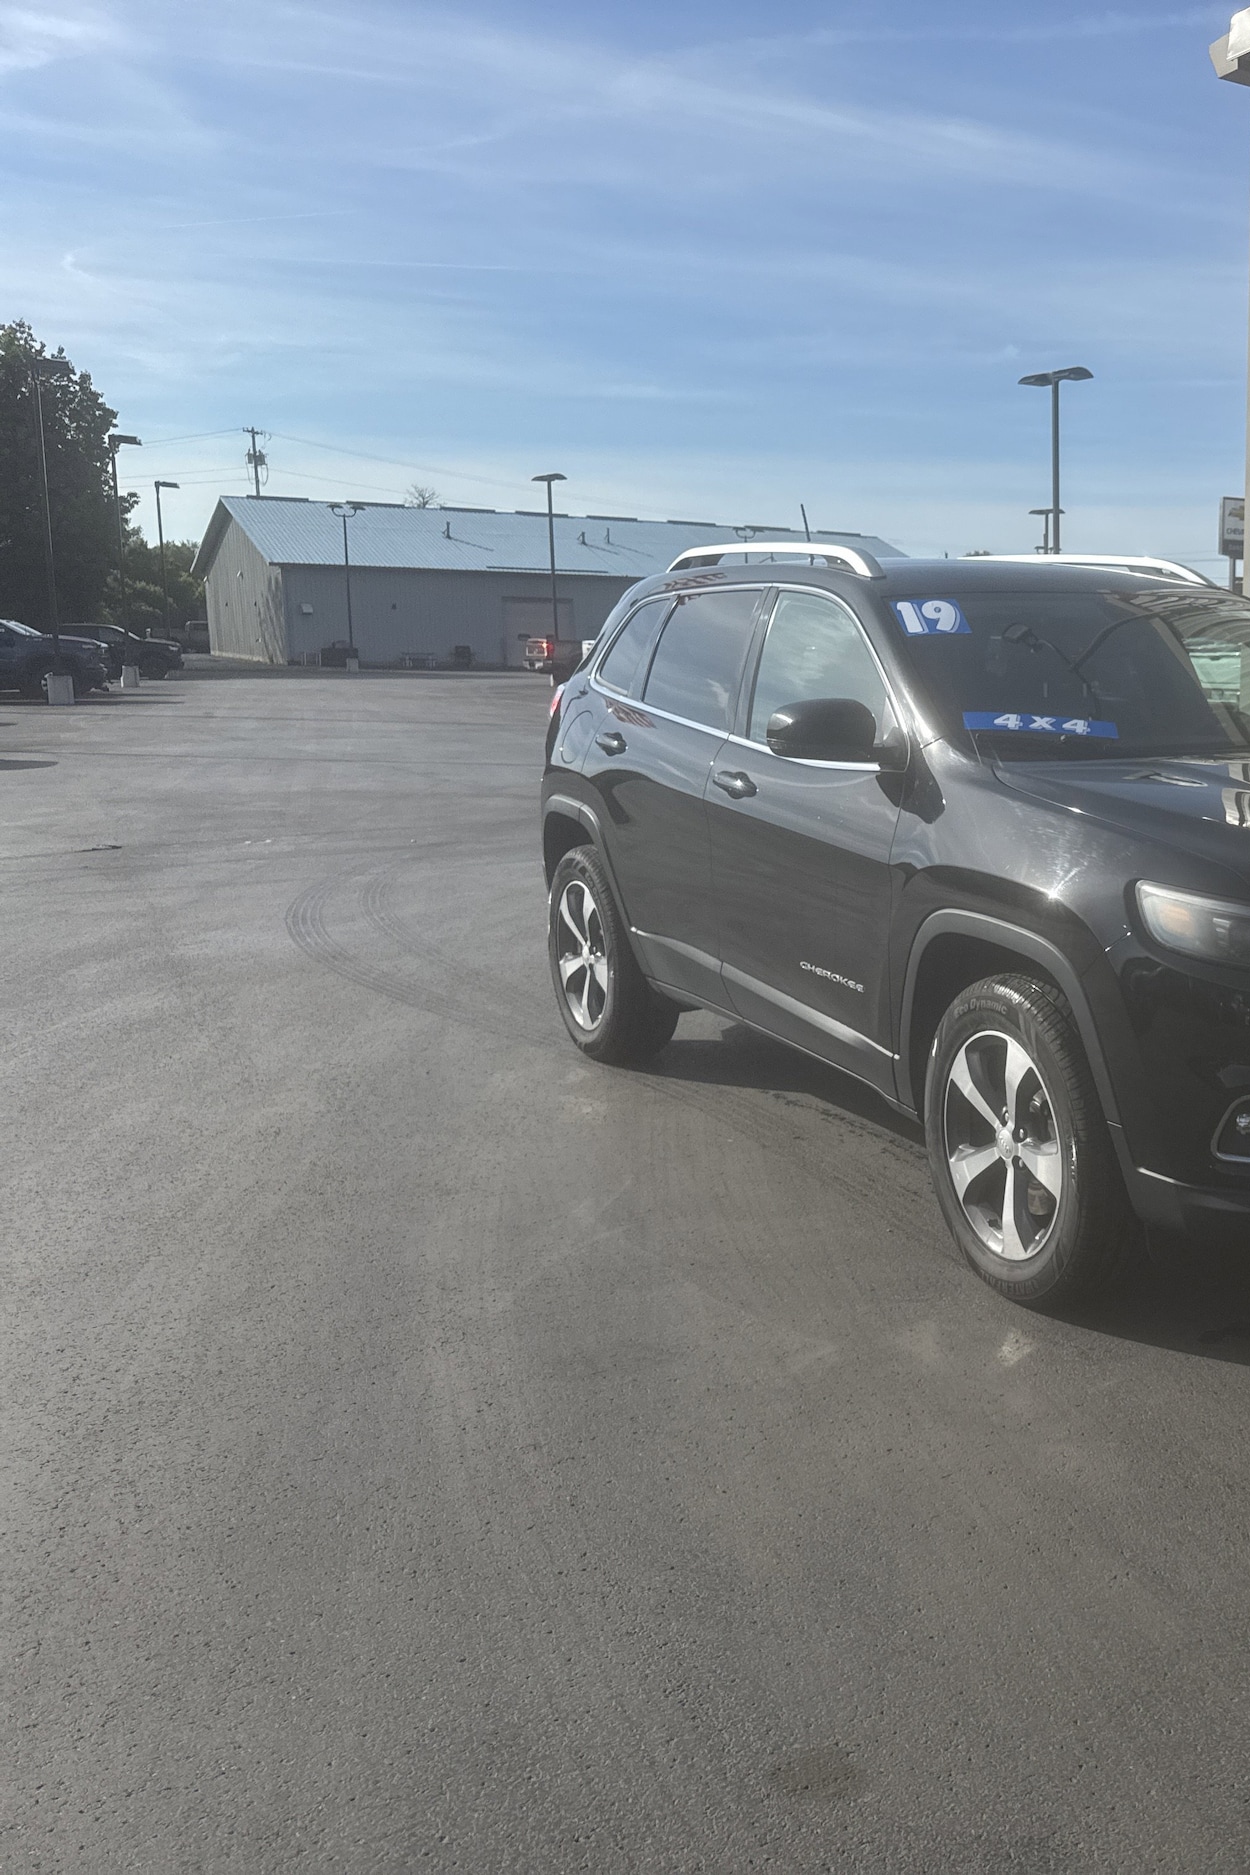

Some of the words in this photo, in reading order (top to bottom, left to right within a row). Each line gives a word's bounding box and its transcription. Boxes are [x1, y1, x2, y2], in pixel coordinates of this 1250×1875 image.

[896, 600, 961, 635] 19
[799, 961, 865, 993] CHEROKEE
[970, 998, 1008, 1015] Dynamic
